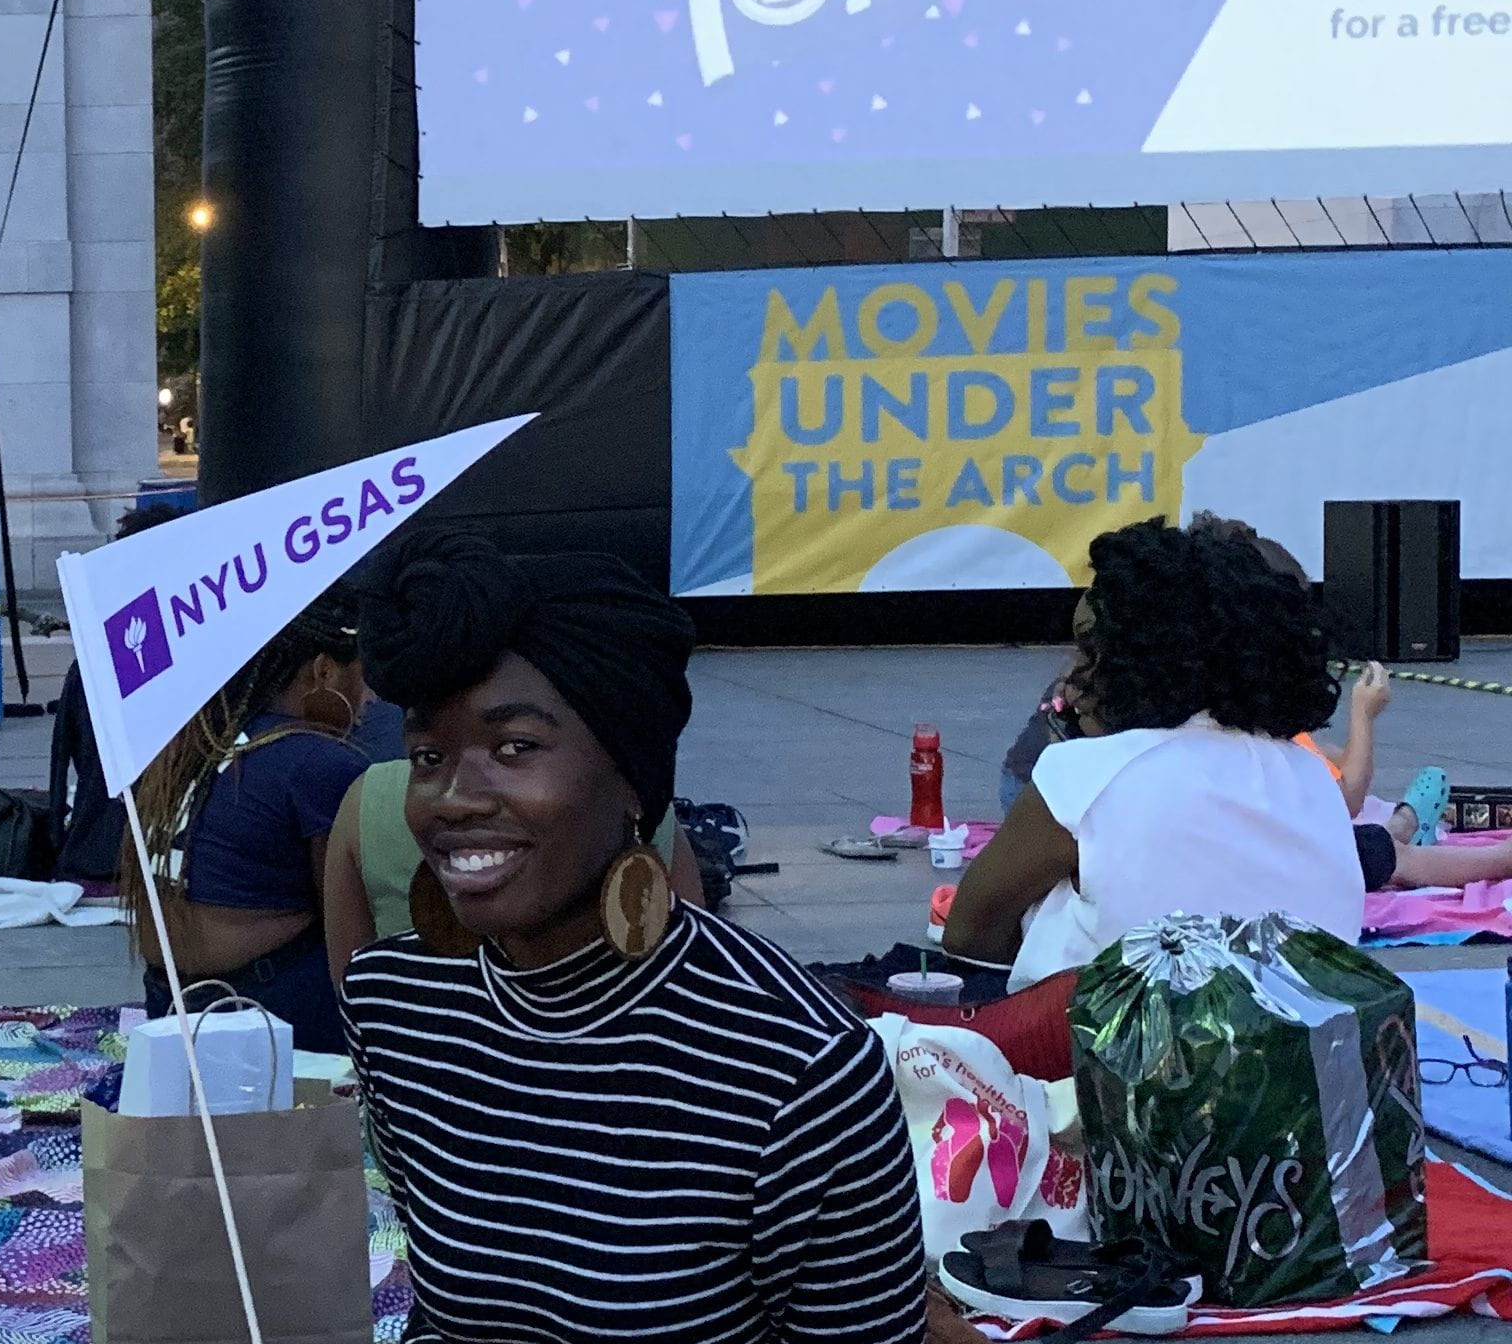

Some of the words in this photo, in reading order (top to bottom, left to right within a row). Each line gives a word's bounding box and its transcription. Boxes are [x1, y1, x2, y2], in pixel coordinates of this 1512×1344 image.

[1330, 7, 1386, 40] for
[1397, 13, 1419, 38] a
[1432, 3, 1512, 37] free
[761, 272, 1183, 362] MOVIES
[778, 364, 1157, 445] UNDER
[781, 458, 922, 514] THE
[946, 449, 1157, 508] ARCH
[169, 541, 269, 638] NYU
[283, 455, 428, 564] GSAS
[913, 1063, 937, 1081] for
